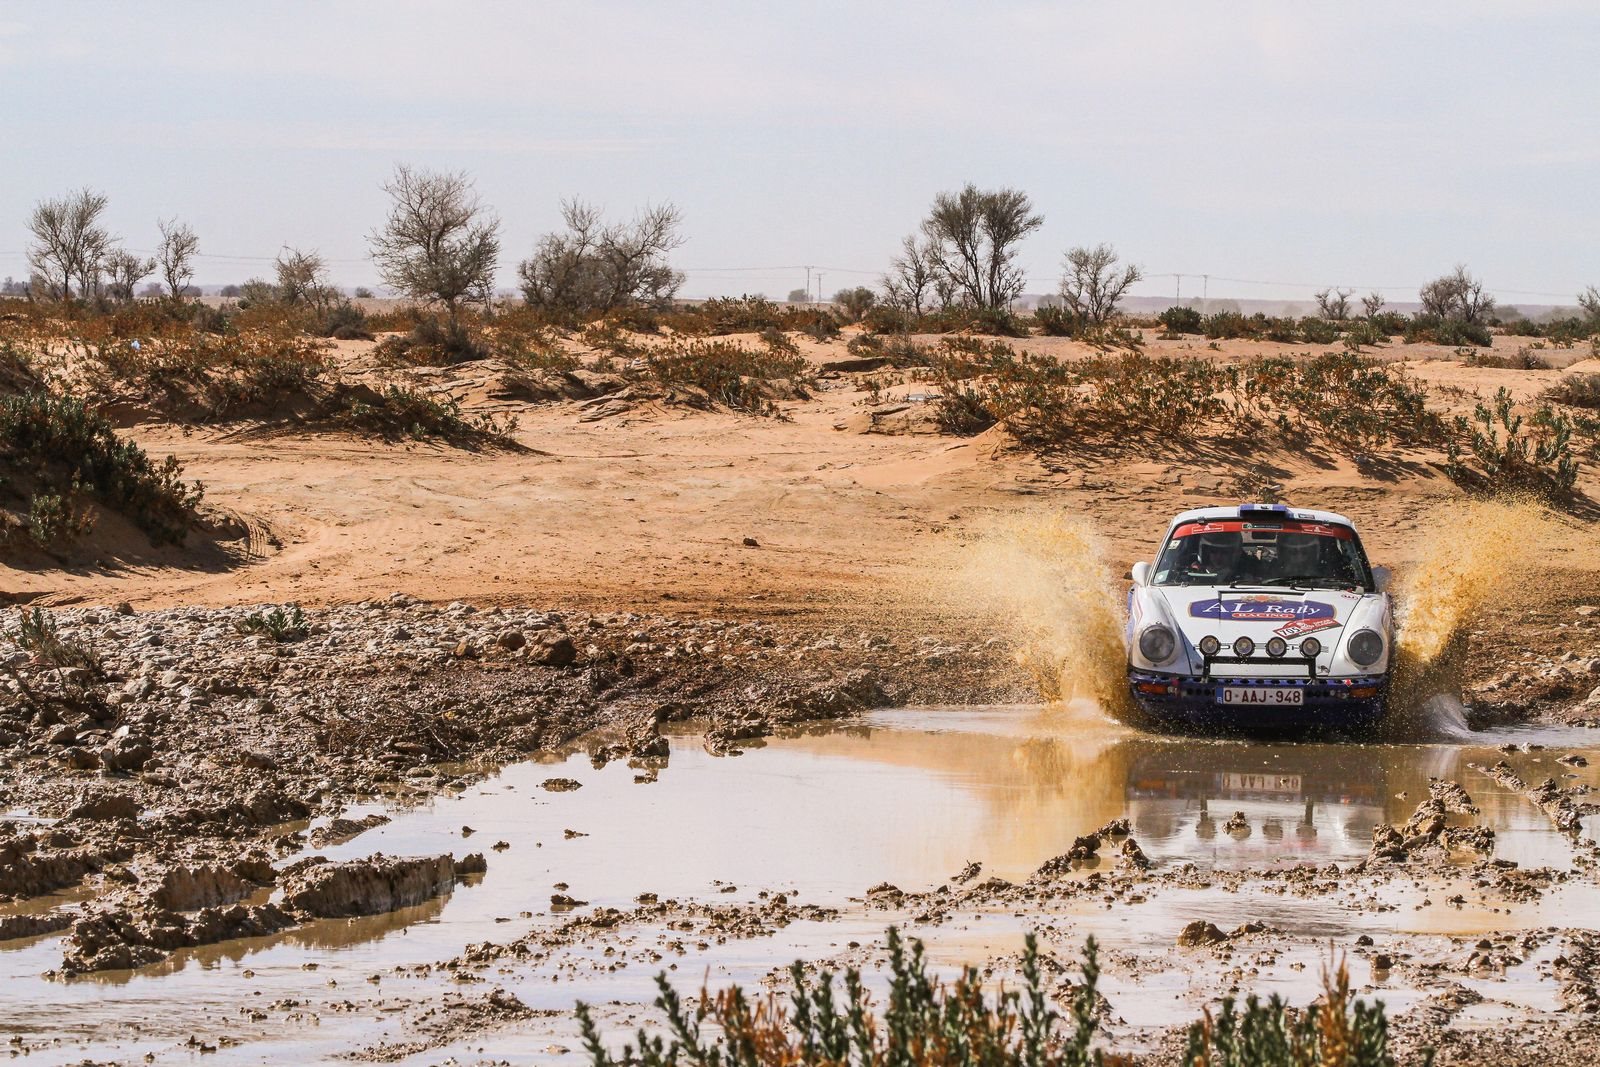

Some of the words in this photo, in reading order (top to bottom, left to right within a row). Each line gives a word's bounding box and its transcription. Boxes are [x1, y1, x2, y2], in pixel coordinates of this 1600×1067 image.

[1202, 602, 1254, 613] AL
[1264, 604, 1320, 616] Rally
[1279, 626, 1301, 636] 705
